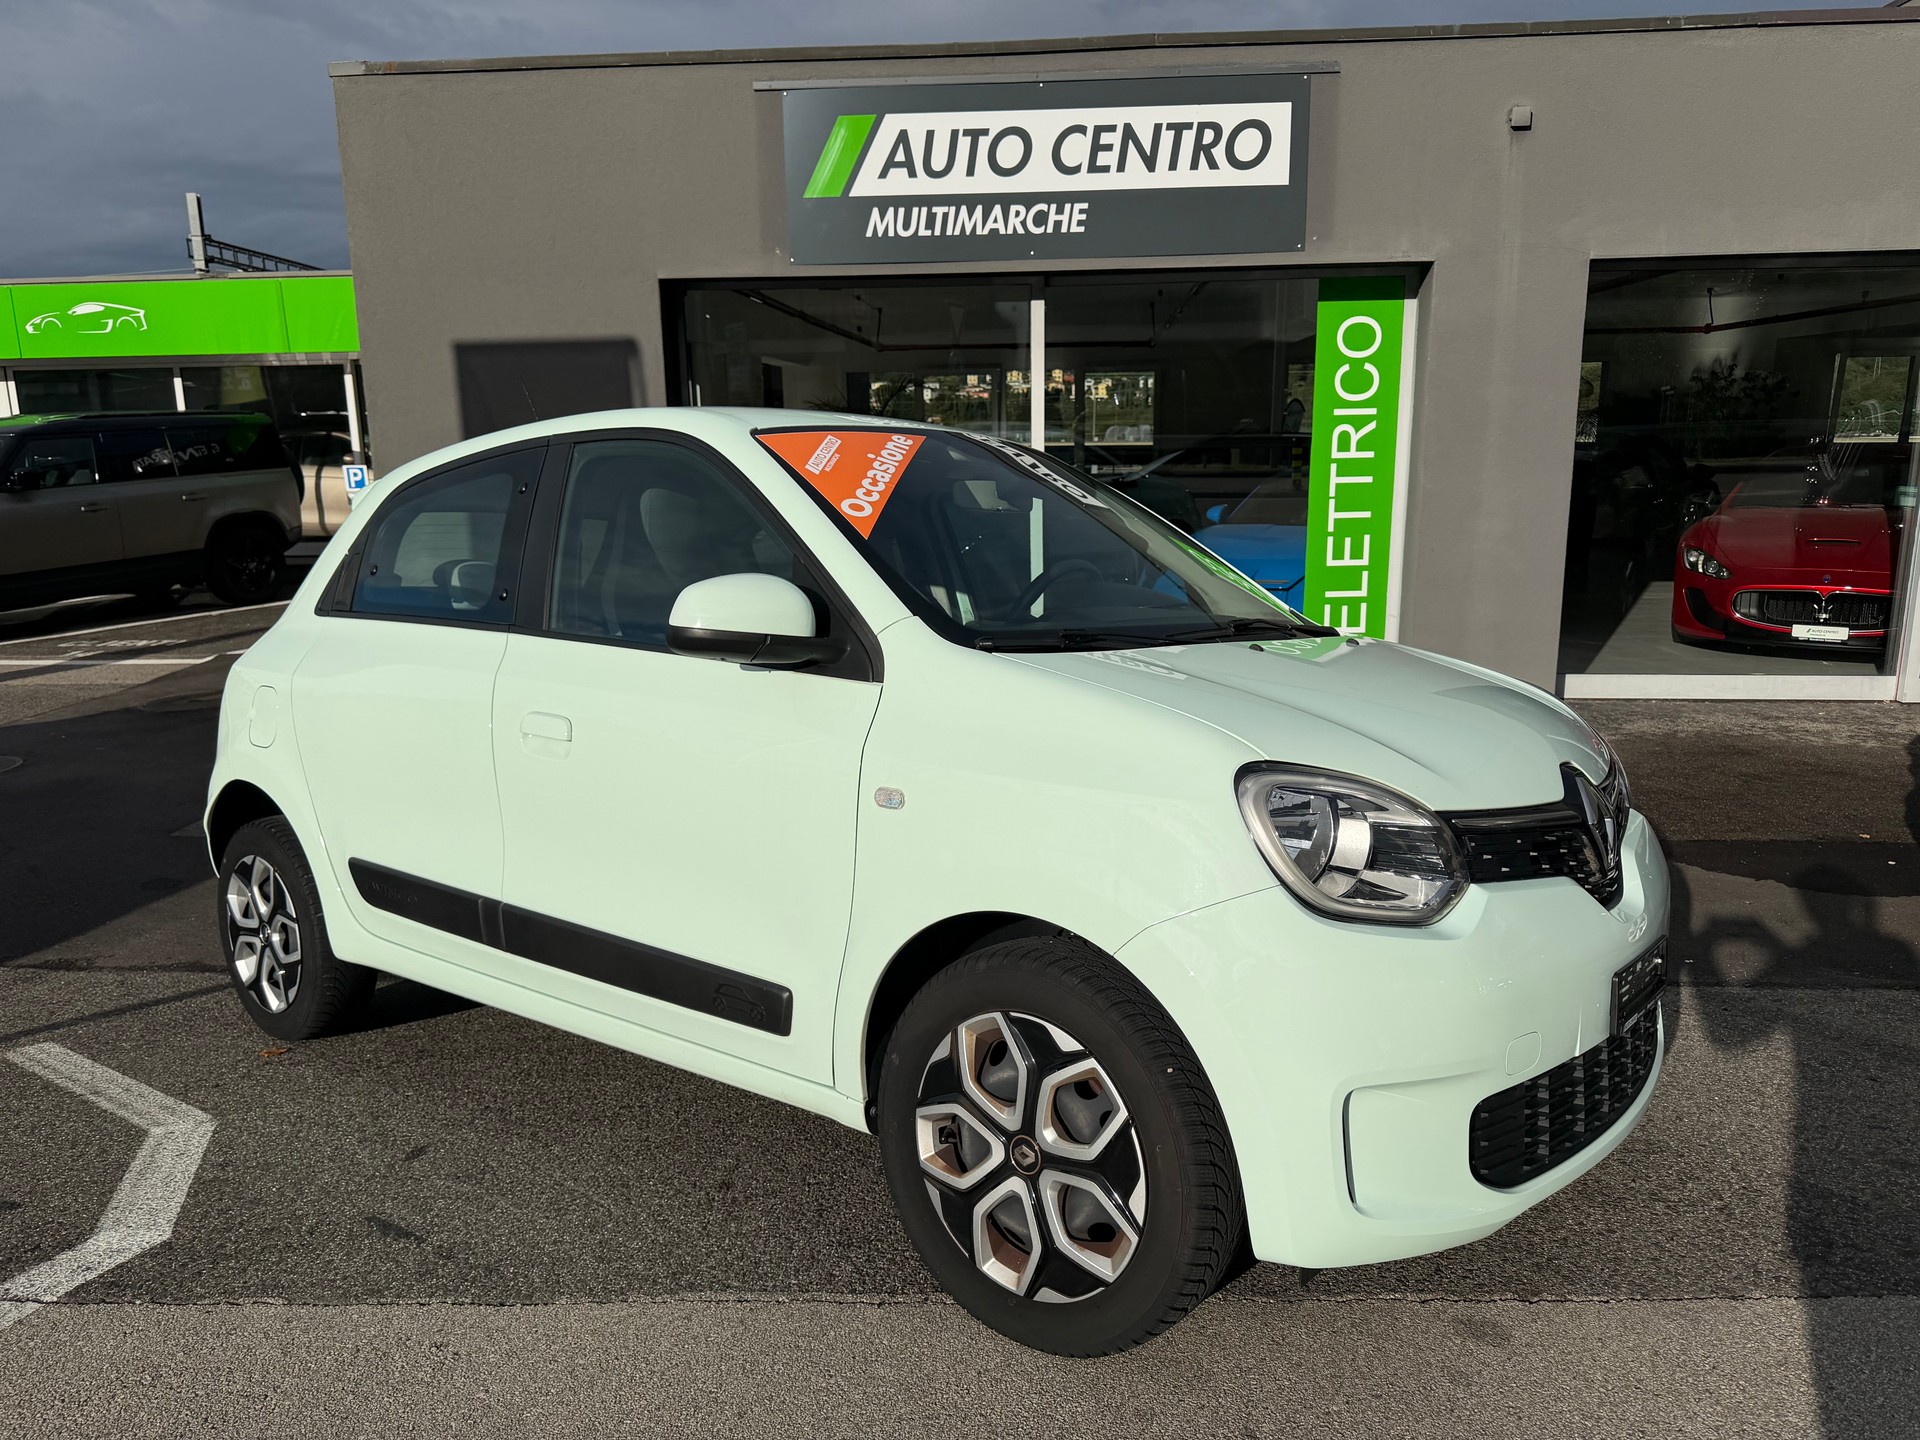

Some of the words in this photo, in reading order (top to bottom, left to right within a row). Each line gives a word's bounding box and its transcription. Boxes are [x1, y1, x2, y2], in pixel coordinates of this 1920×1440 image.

[877, 125, 1034, 180] AUTO
[1050, 117, 1273, 176] CENTRO
[865, 201, 1090, 238] MULTIMARCHE
[811, 453, 827, 468] AUTO
[820, 437, 839, 455] CENTRO
[840, 434, 914, 517] Occasione
[1323, 315, 1383, 635] ELETTRICO
[349, 468, 363, 488] P
